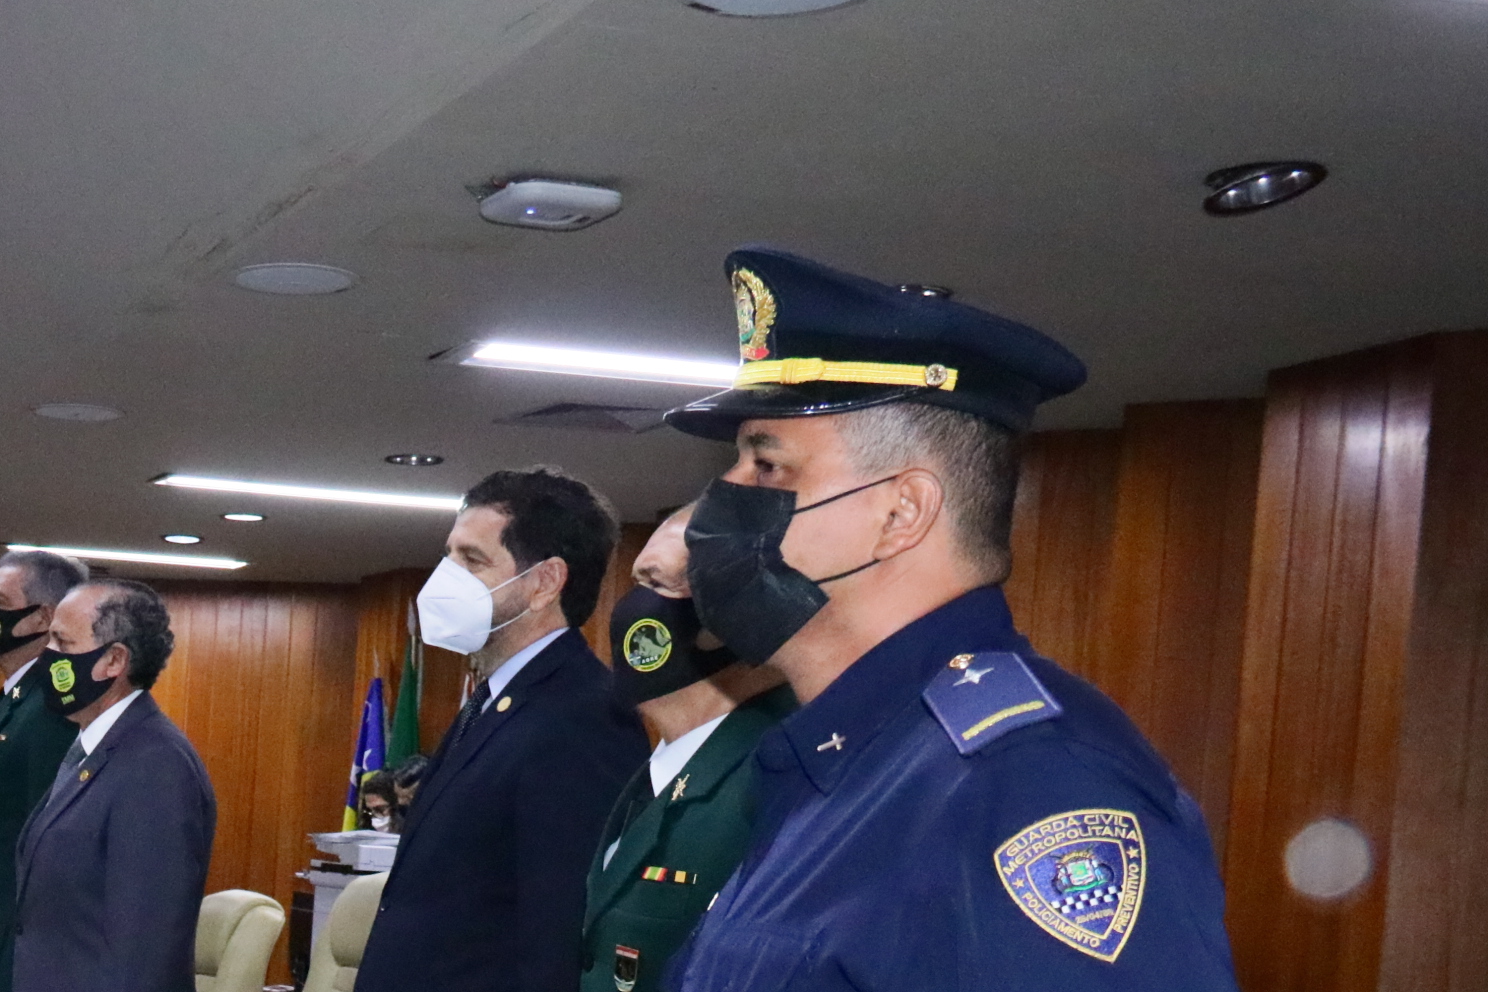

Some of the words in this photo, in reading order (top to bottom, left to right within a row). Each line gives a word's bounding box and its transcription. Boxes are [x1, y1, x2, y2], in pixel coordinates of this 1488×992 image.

[1002, 826, 1139, 876] METROPOLITANA
[1006, 817, 1080, 857] GUARDA
[1083, 814, 1129, 828] CIVIL
[1022, 892, 1100, 948] POLICIAMENTO
[1112, 864, 1140, 933] PREVENTIVO
